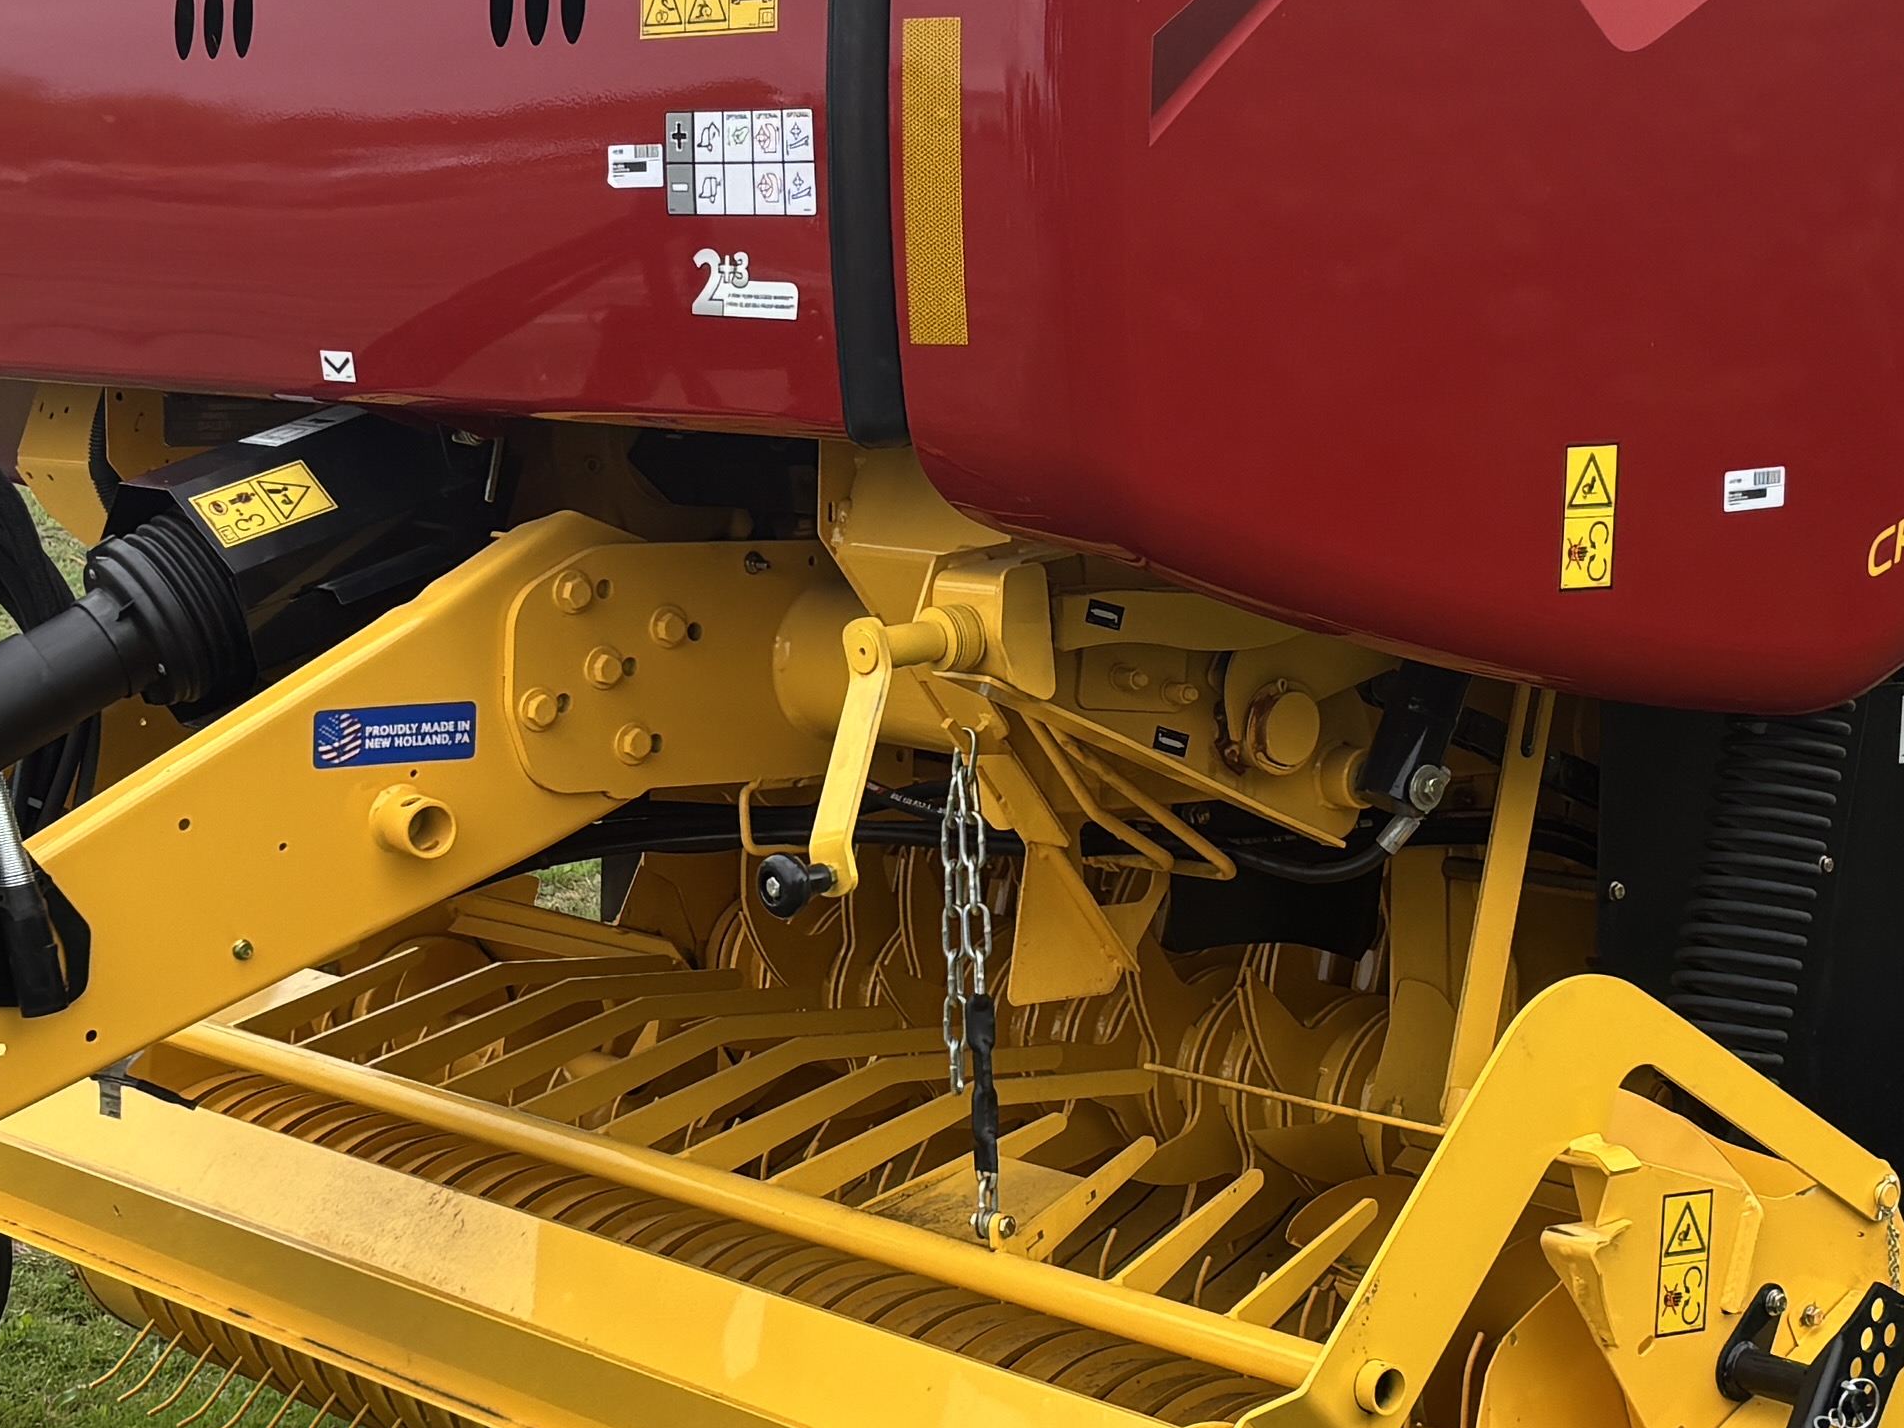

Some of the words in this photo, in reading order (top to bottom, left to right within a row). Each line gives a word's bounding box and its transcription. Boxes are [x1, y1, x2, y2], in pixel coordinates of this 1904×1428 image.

[364, 722, 419, 737] PROUDLY
[421, 721, 456, 734] MADE
[457, 720, 471, 732] IN
[364, 737, 392, 750] NEW
[393, 733, 453, 748] HOLLAND,
[454, 732, 471, 744] PA
